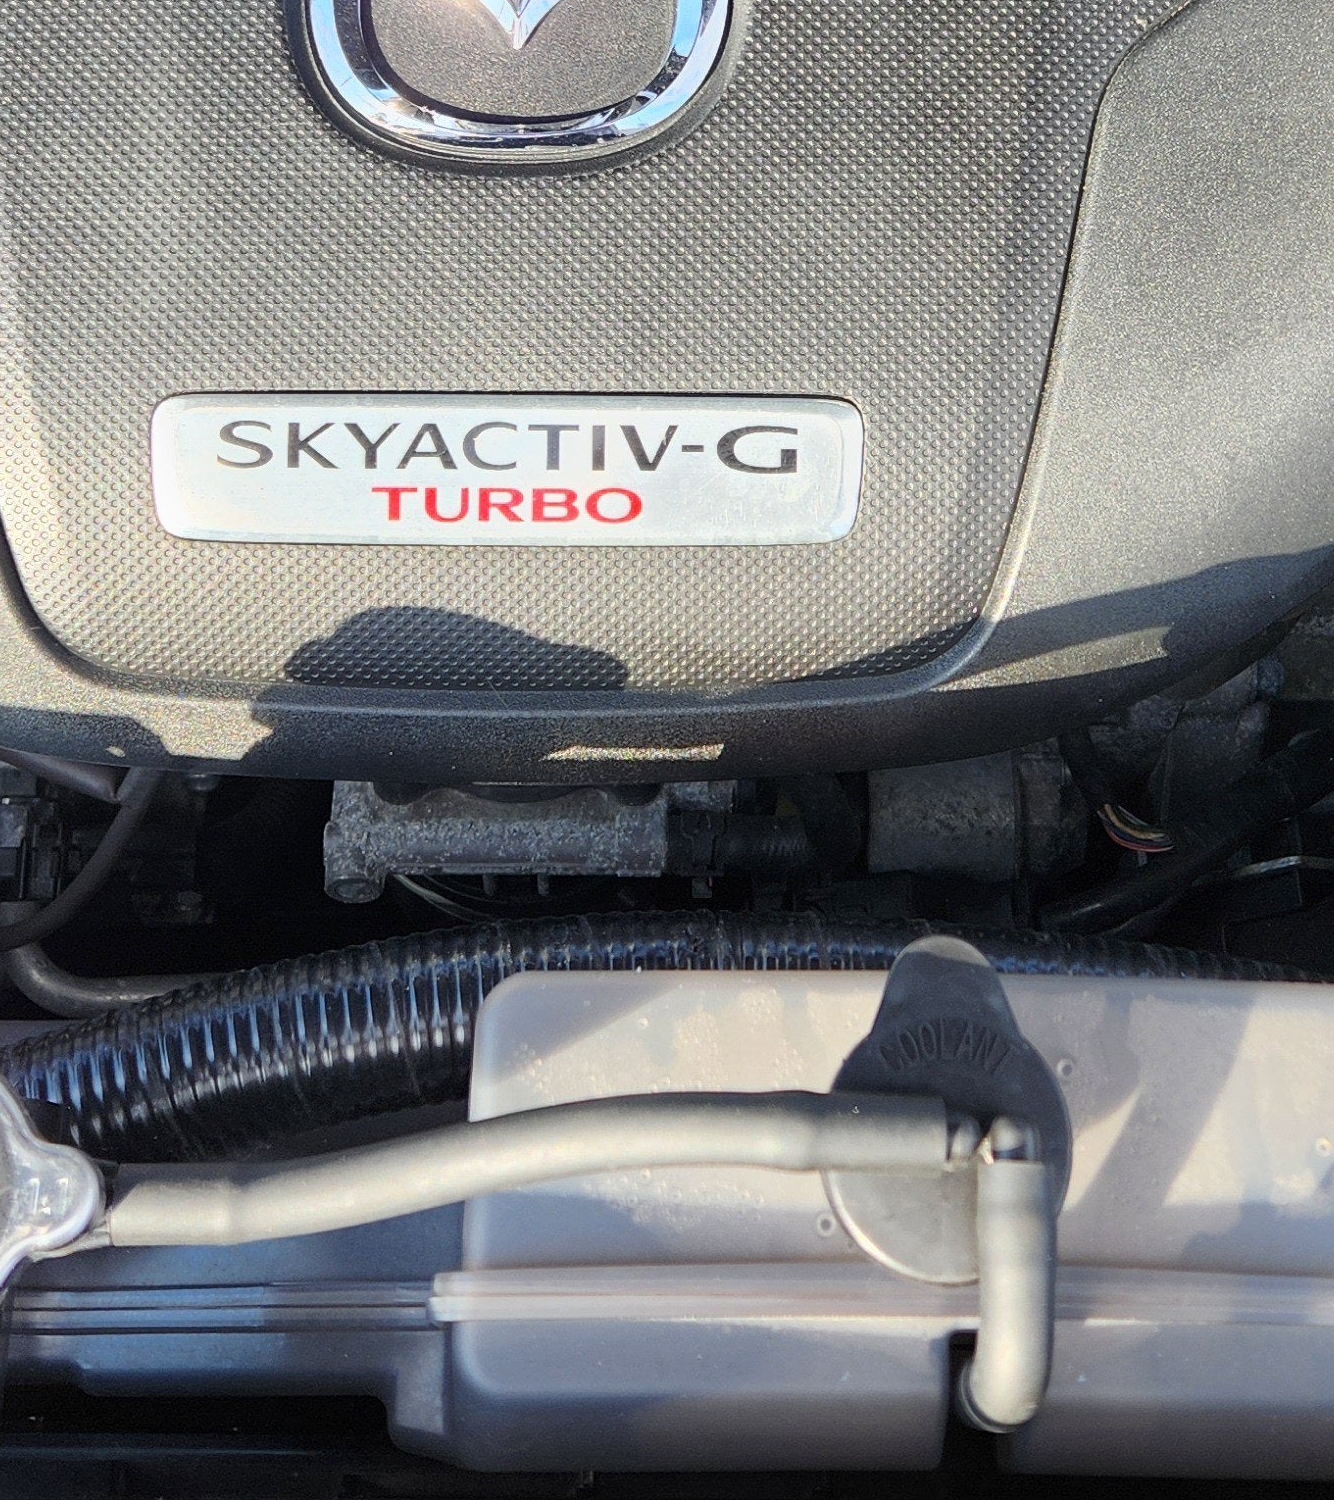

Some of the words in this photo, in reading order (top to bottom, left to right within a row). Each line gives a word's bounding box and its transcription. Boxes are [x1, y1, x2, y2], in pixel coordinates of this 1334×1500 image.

[215, 420, 798, 475] SKYACTIV-G
[371, 486, 644, 525] TURBO
[878, 1017, 1012, 1075] COOLANT
